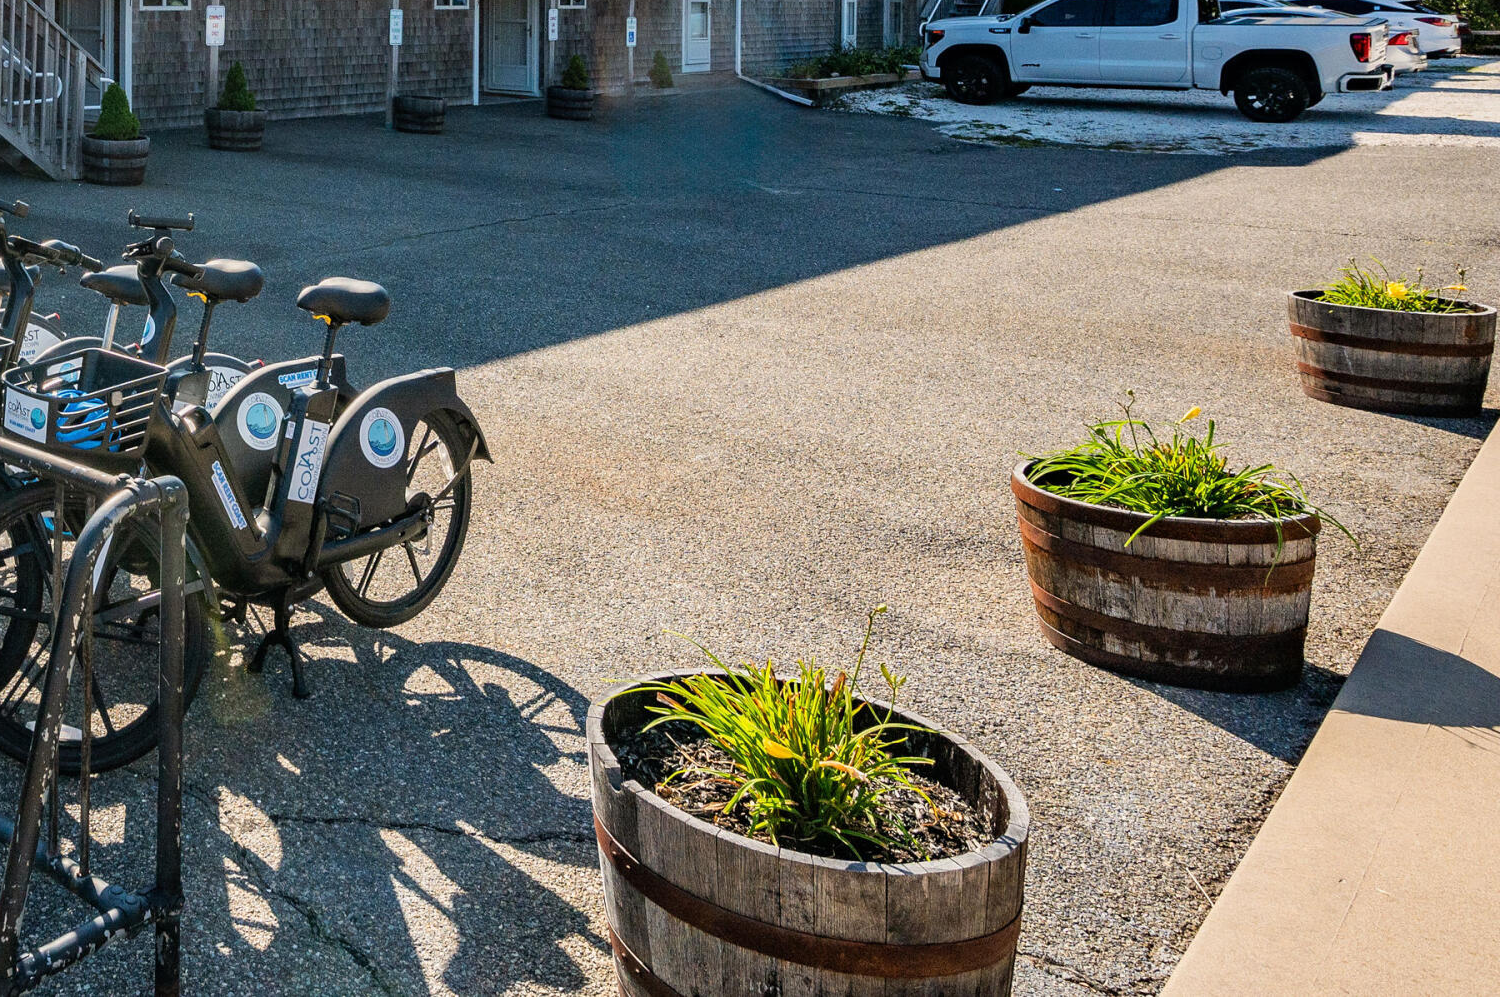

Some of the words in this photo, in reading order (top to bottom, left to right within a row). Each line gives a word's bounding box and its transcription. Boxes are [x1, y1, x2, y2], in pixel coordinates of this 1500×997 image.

[208, 371, 242, 392] OAST
[279, 373, 296, 384] SCAN
[297, 370, 313, 380] RENT
[7, 399, 30, 417] COAST
[297, 423, 322, 500] COAST
[212, 462, 225, 483] SCAN
[223, 483, 235, 503] RENT
[232, 503, 247, 528] COAST
